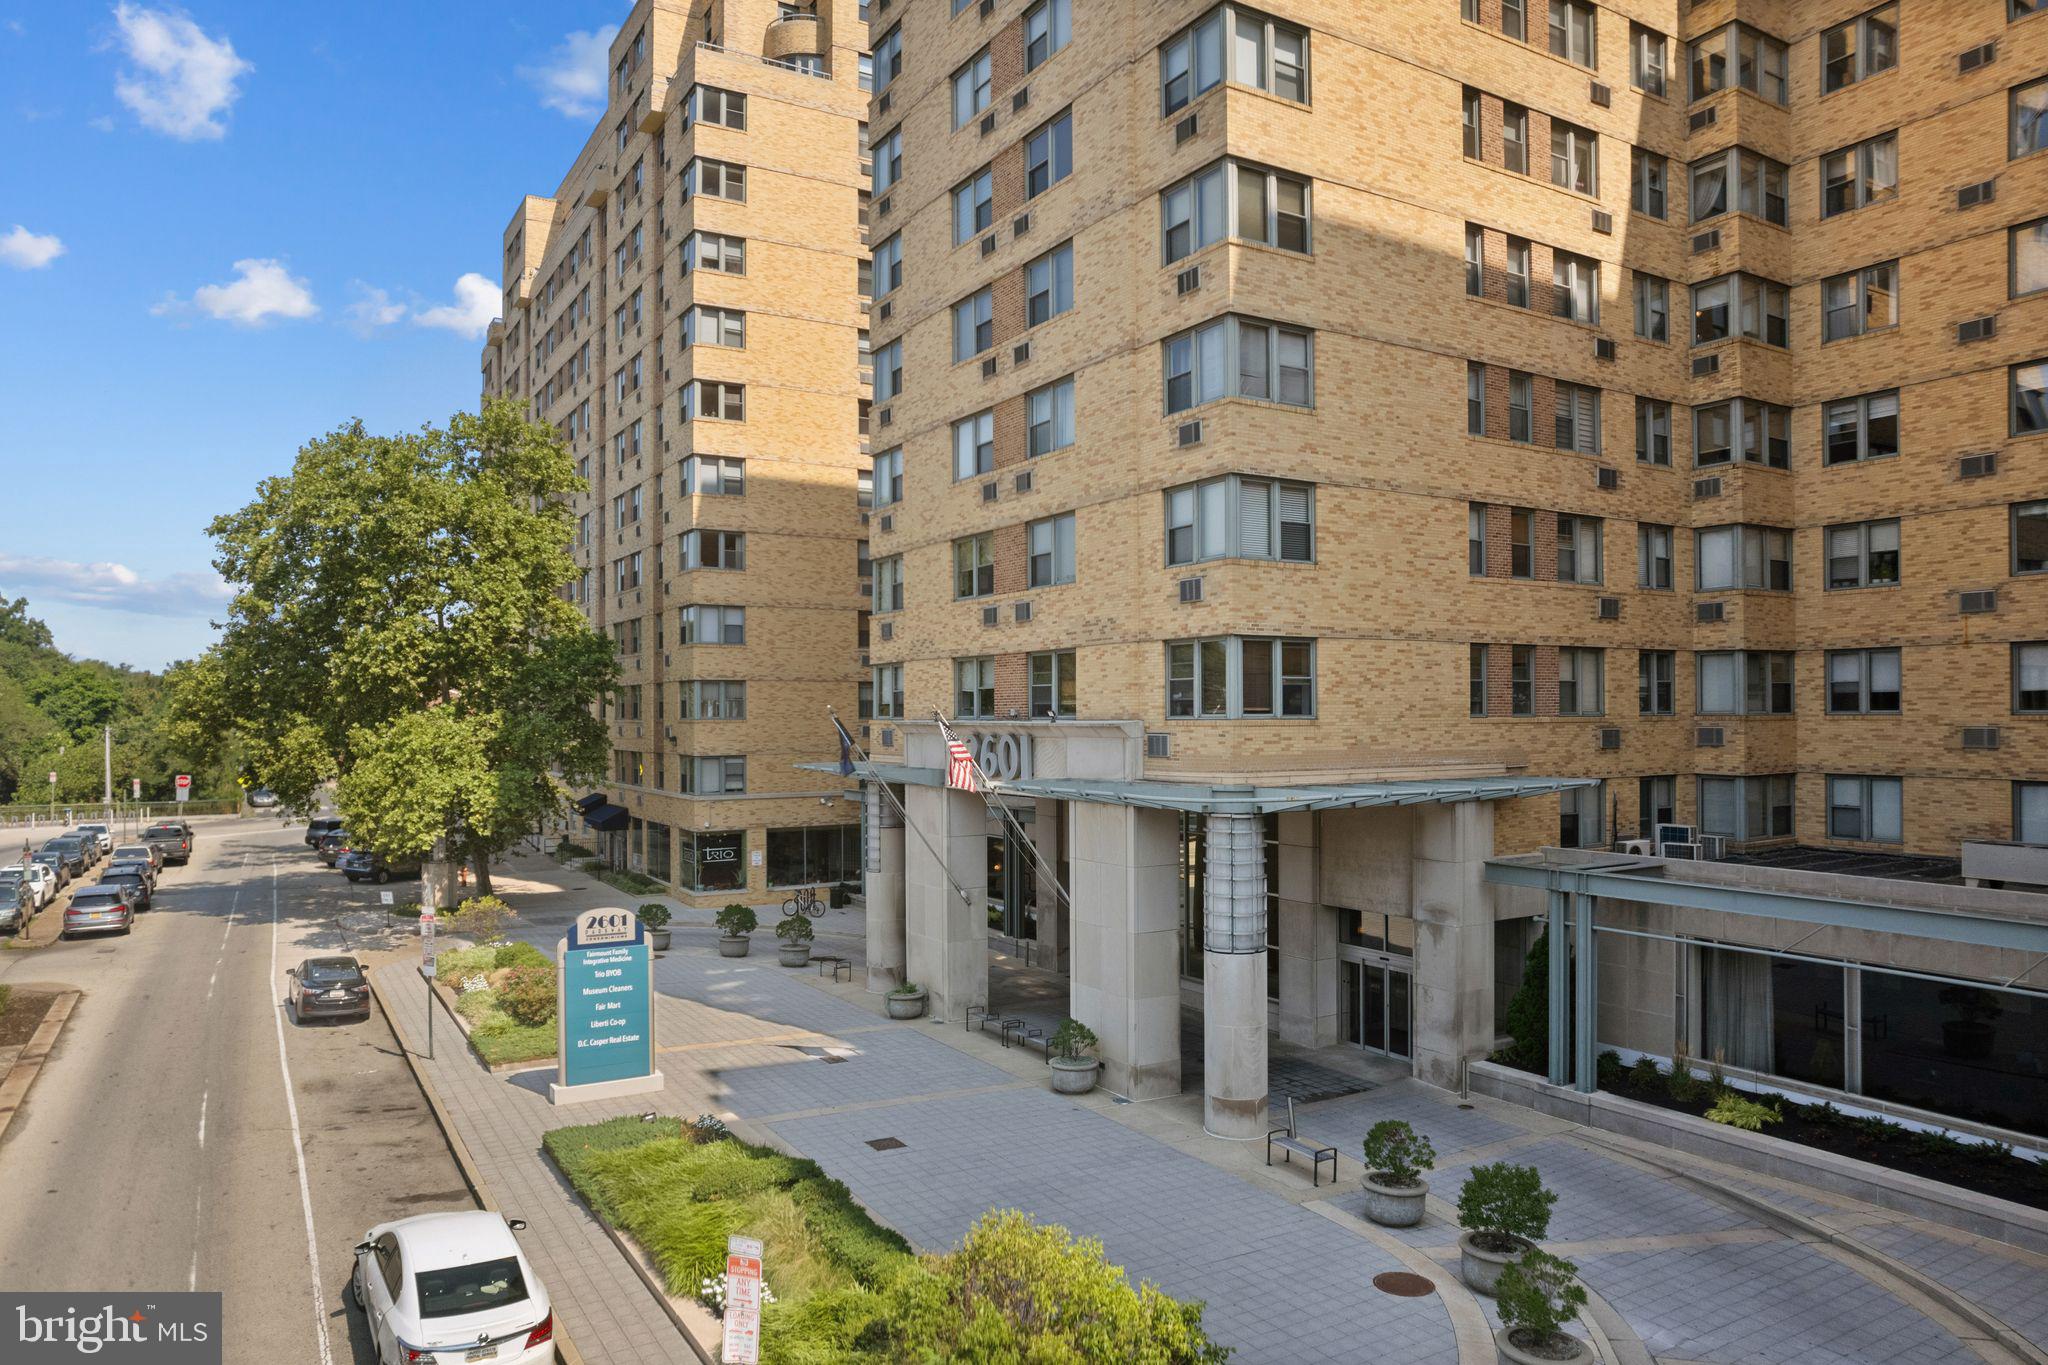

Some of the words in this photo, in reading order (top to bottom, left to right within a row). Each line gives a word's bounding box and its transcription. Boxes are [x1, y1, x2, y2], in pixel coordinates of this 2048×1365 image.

[585, 914, 627, 929] 2601
[612, 948, 628, 956] Family
[583, 957, 609, 966] Integrative
[609, 955, 632, 963] Medicine
[594, 970, 605, 978] Trio
[605, 968, 622, 977] BYOB
[582, 987, 608, 995] Museum
[608, 985, 633, 993] Cleaners
[595, 1003, 606, 1011] Fair
[609, 1018, 626, 1027] Co-op
[577, 1039, 589, 1048] D.C.
[589, 1038, 609, 1046] Casper
[609, 1036, 622, 1044] Real
[622, 1034, 640, 1042] Estate
[730, 1265, 758, 1276] STOPPING
[736, 1278, 751, 1287] ANY
[736, 1287, 752, 1297] TIME
